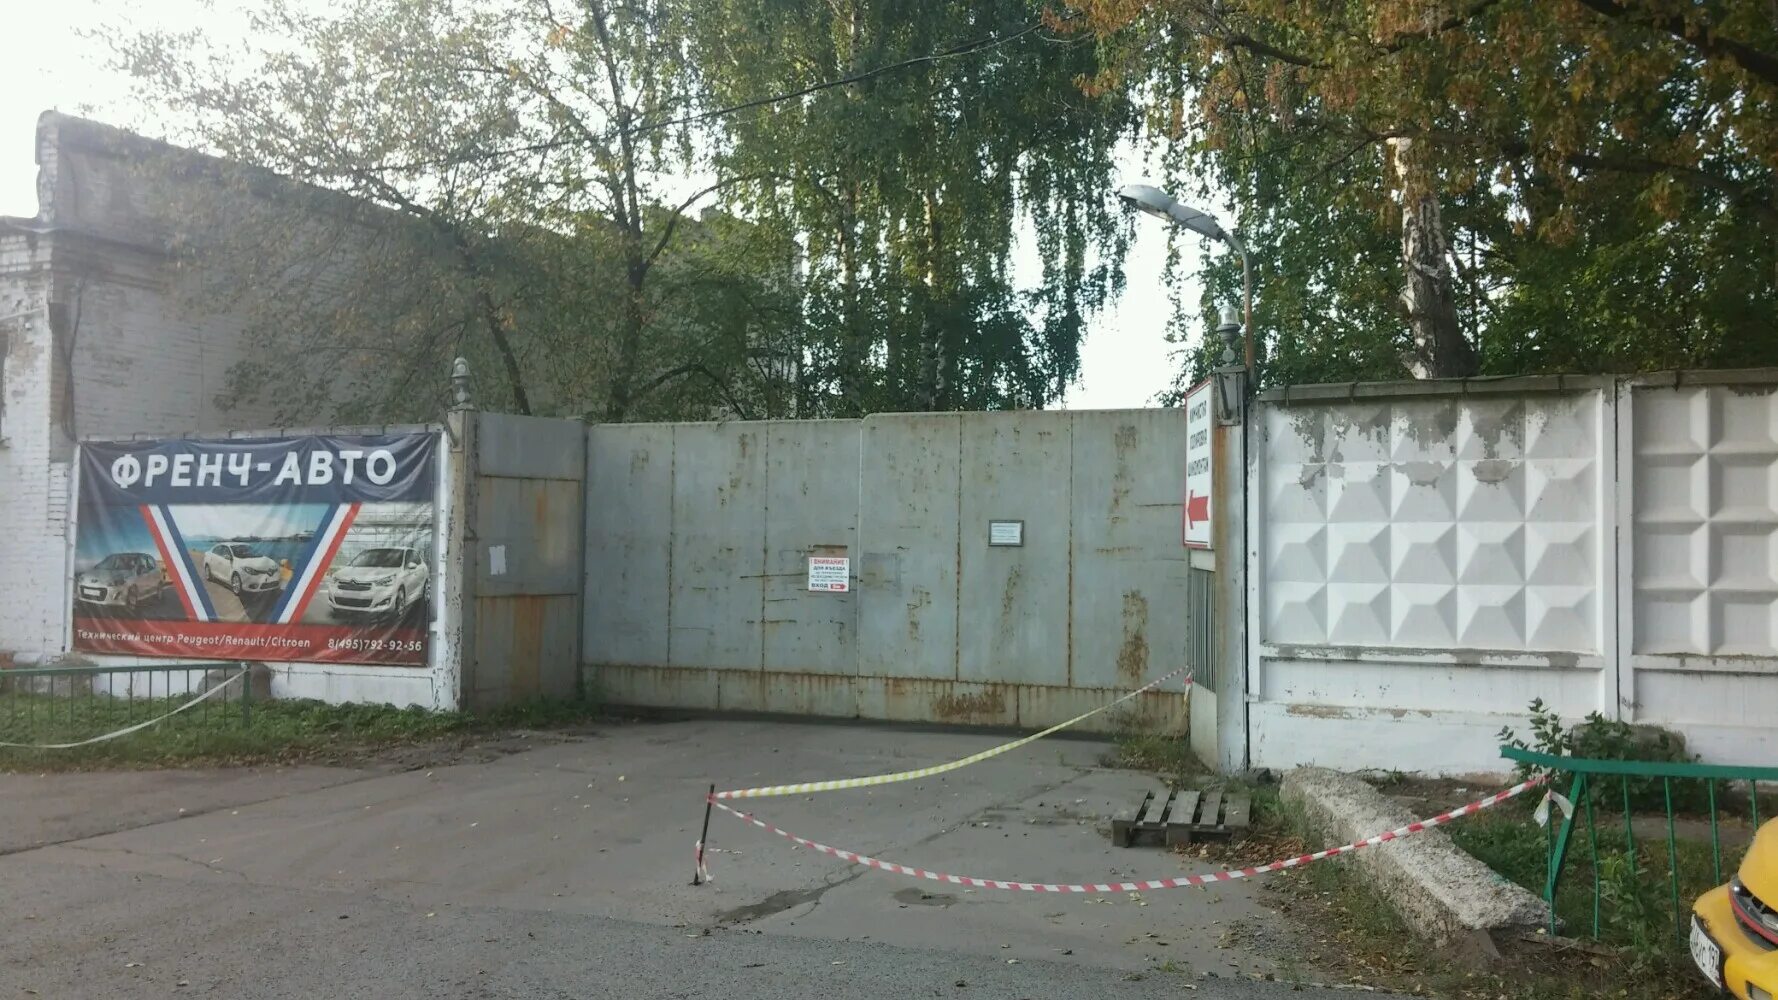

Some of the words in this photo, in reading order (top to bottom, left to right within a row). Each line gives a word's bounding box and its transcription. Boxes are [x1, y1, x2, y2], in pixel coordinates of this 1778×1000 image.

[111, 449, 397, 488] ФРЕНЧ-АВТО
[77, 629, 141, 641] Технический
[144, 634, 174, 644] центр
[328, 638, 422, 651] 8(495)792-92-56
